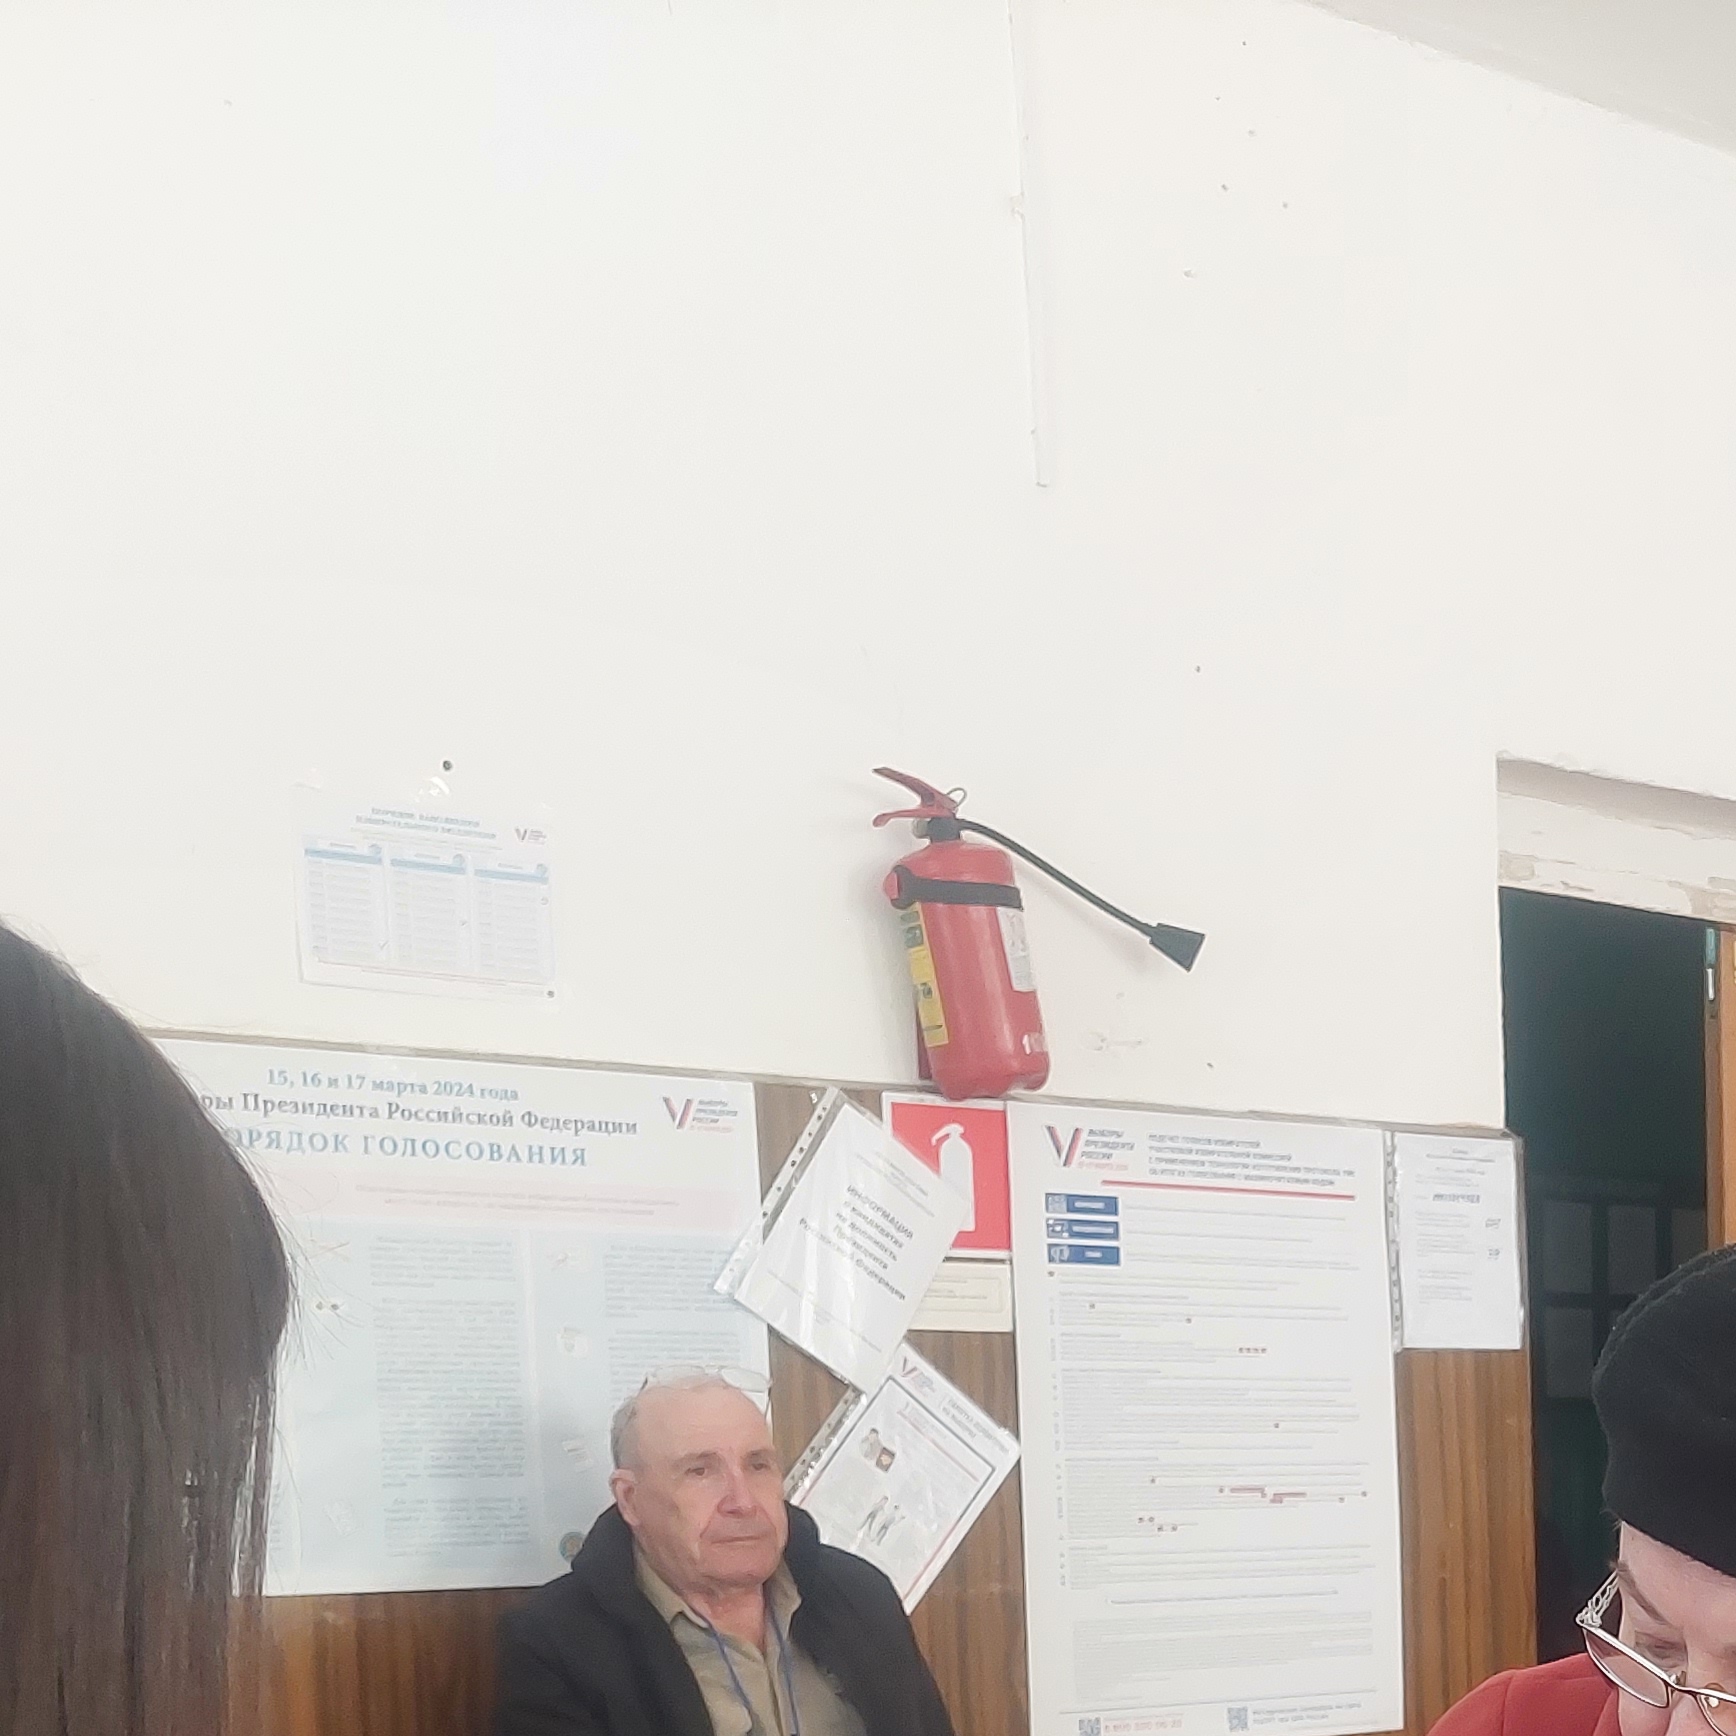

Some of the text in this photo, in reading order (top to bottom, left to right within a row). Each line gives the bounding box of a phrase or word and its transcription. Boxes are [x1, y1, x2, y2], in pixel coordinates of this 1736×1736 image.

[267, 1067, 521, 1103] 15, 16 и 17 марта 2024 года
[238, 1091, 381, 1120] Президента
[385, 1100, 515, 1129] Российской
[519, 1109, 639, 1138] Федерации
[362, 1133, 587, 1168] ГОЛОСОВАНИЯ
